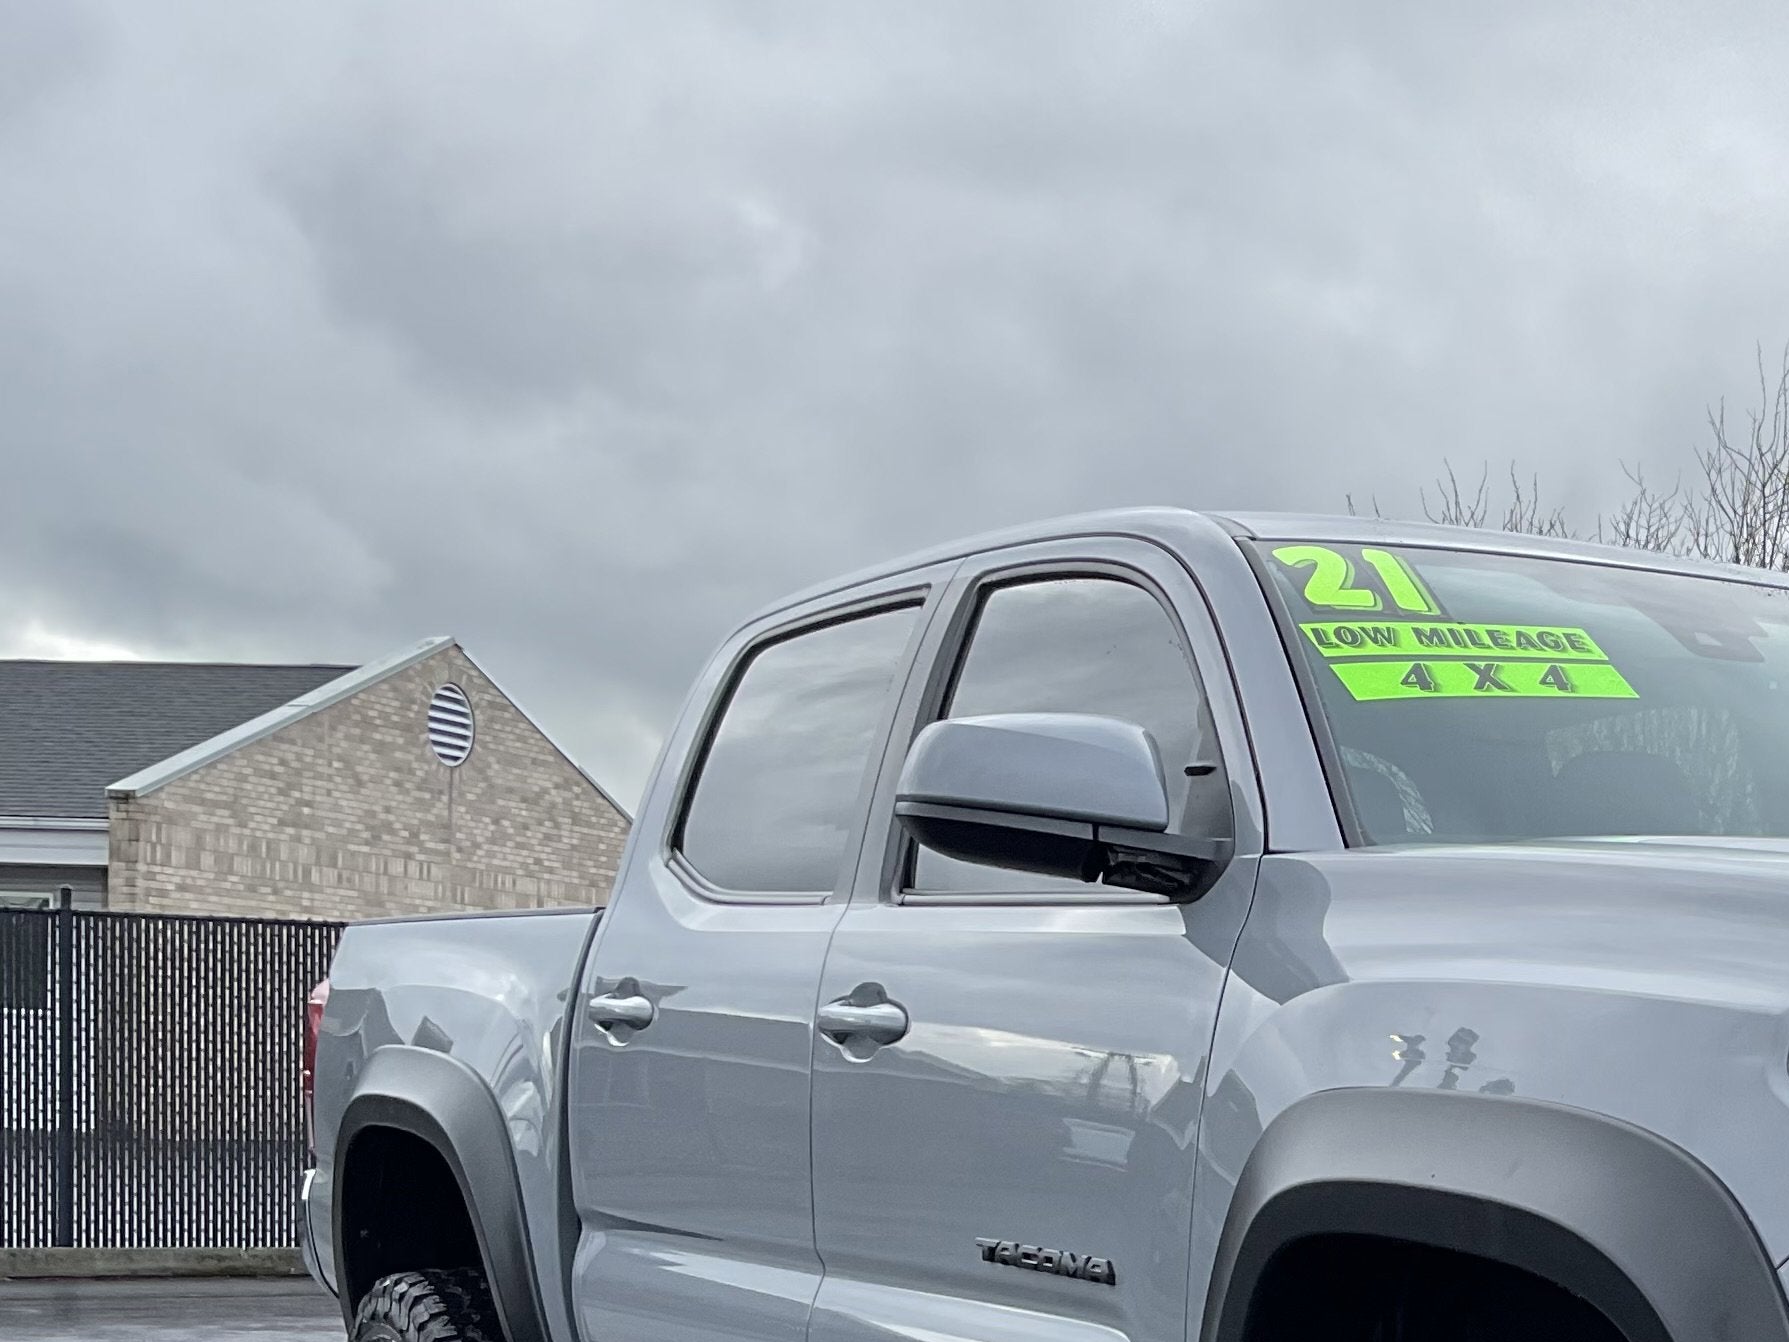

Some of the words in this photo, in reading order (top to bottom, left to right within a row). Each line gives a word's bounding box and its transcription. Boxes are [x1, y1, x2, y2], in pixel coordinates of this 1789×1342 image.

[1272, 545, 1442, 616] 21
[1310, 625, 1397, 649] LOW
[1411, 627, 1592, 653] MILEAGE
[1400, 662, 1436, 692] 4
[1463, 663, 1507, 693] X
[1538, 664, 1575, 693] 4
